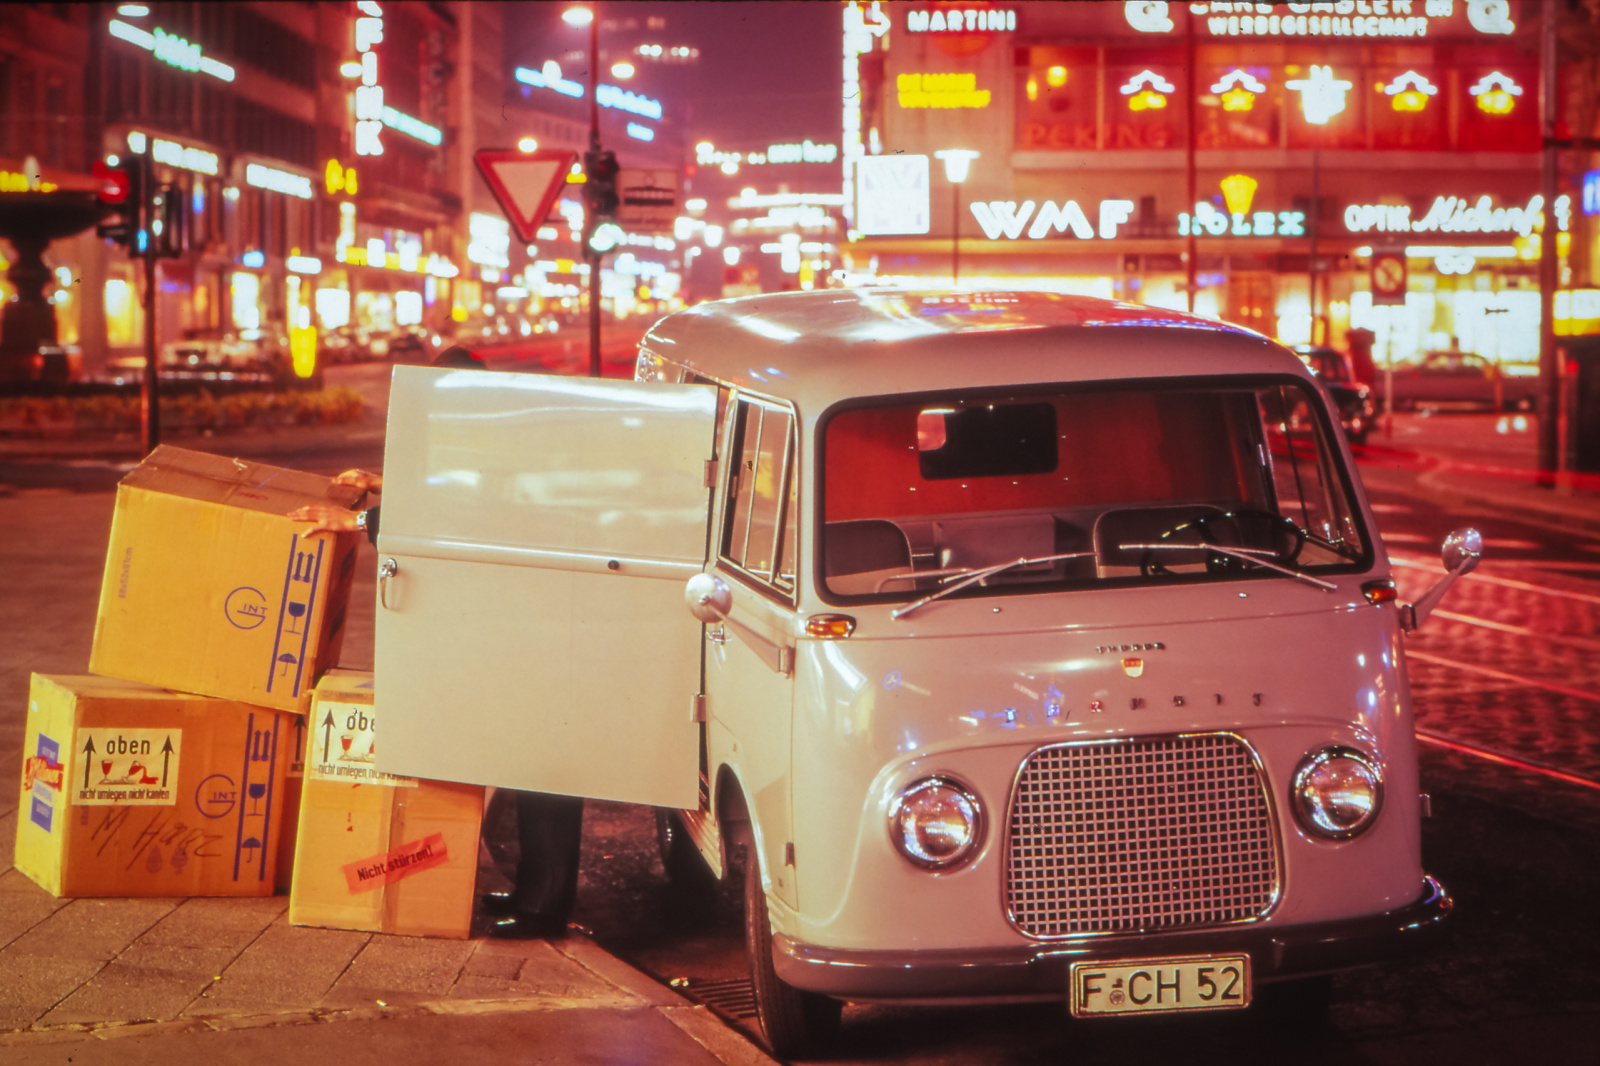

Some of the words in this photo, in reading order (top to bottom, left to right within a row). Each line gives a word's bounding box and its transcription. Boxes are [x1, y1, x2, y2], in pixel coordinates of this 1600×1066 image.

[907, 10, 1016, 32] MARTINI
[969, 199, 1135, 240] WMF
[106, 735, 151, 755] oben
[79, 788, 96, 800] nicht
[128, 788, 145, 800] nicht
[357, 861, 386, 882] Nicht
[387, 844, 434, 873] stürzen!
[1197, 965, 1241, 1002] 52
